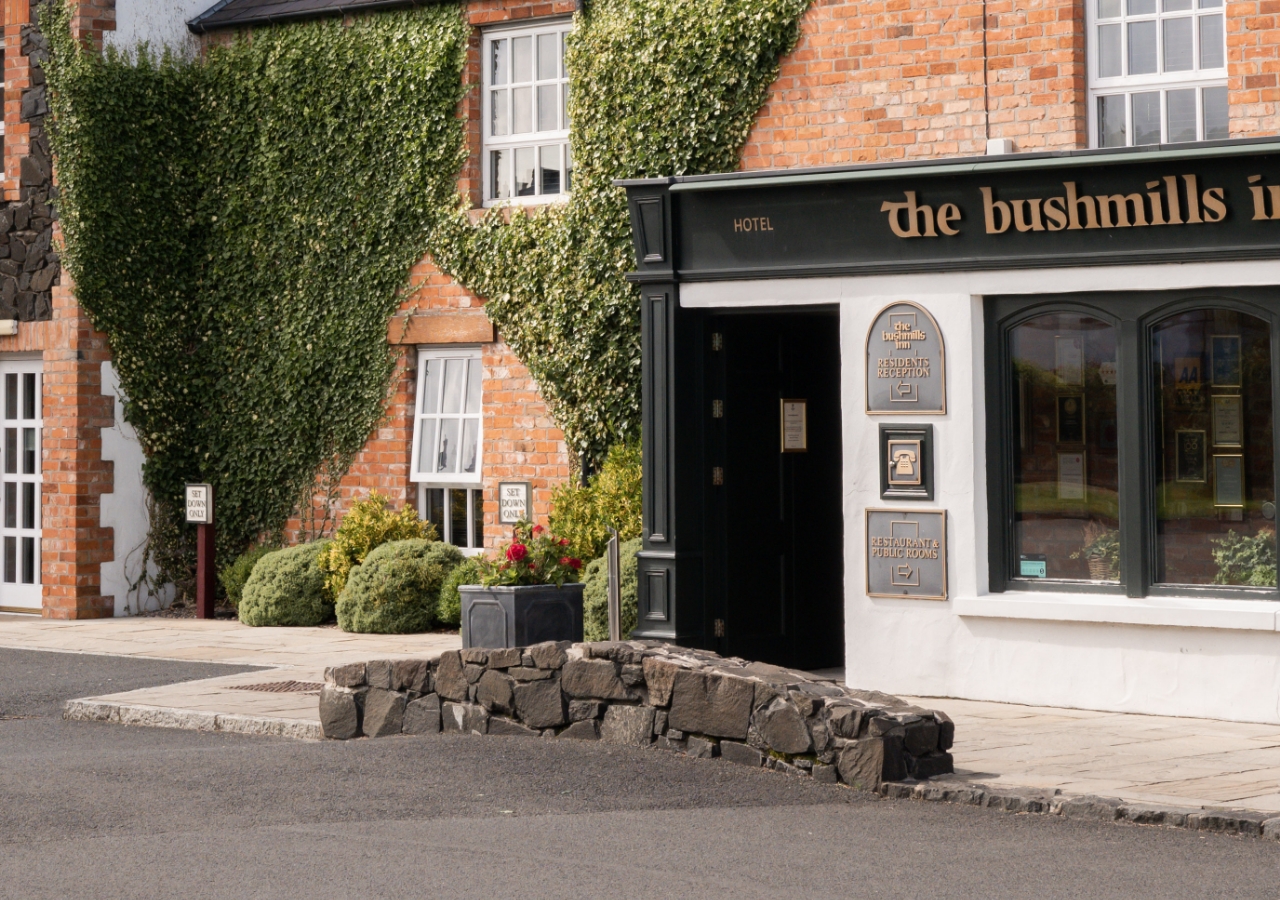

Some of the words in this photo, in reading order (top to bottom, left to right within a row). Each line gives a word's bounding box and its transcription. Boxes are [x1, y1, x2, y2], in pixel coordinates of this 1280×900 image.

[880, 191, 962, 238] the
[979, 173, 1227, 234] bushmills
[733, 217, 774, 232] HOTEL
[894, 321, 911, 331] the
[882, 330, 927, 341] bushmills
[895, 340, 912, 350] inn
[878, 357, 930, 368] RESIDENTS
[877, 367, 931, 379] RECEPTION
[191, 490, 202, 498] SET
[506, 488, 520, 497] SET
[187, 500, 206, 508] DOWN
[501, 498, 525, 508] DOWN
[189, 509, 204, 518] ONLY
[871, 536, 931, 548] RESTAURANT
[932, 539, 940, 549] &
[872, 547, 903, 558] PUBLIC
[906, 548, 939, 559] ROOMS
